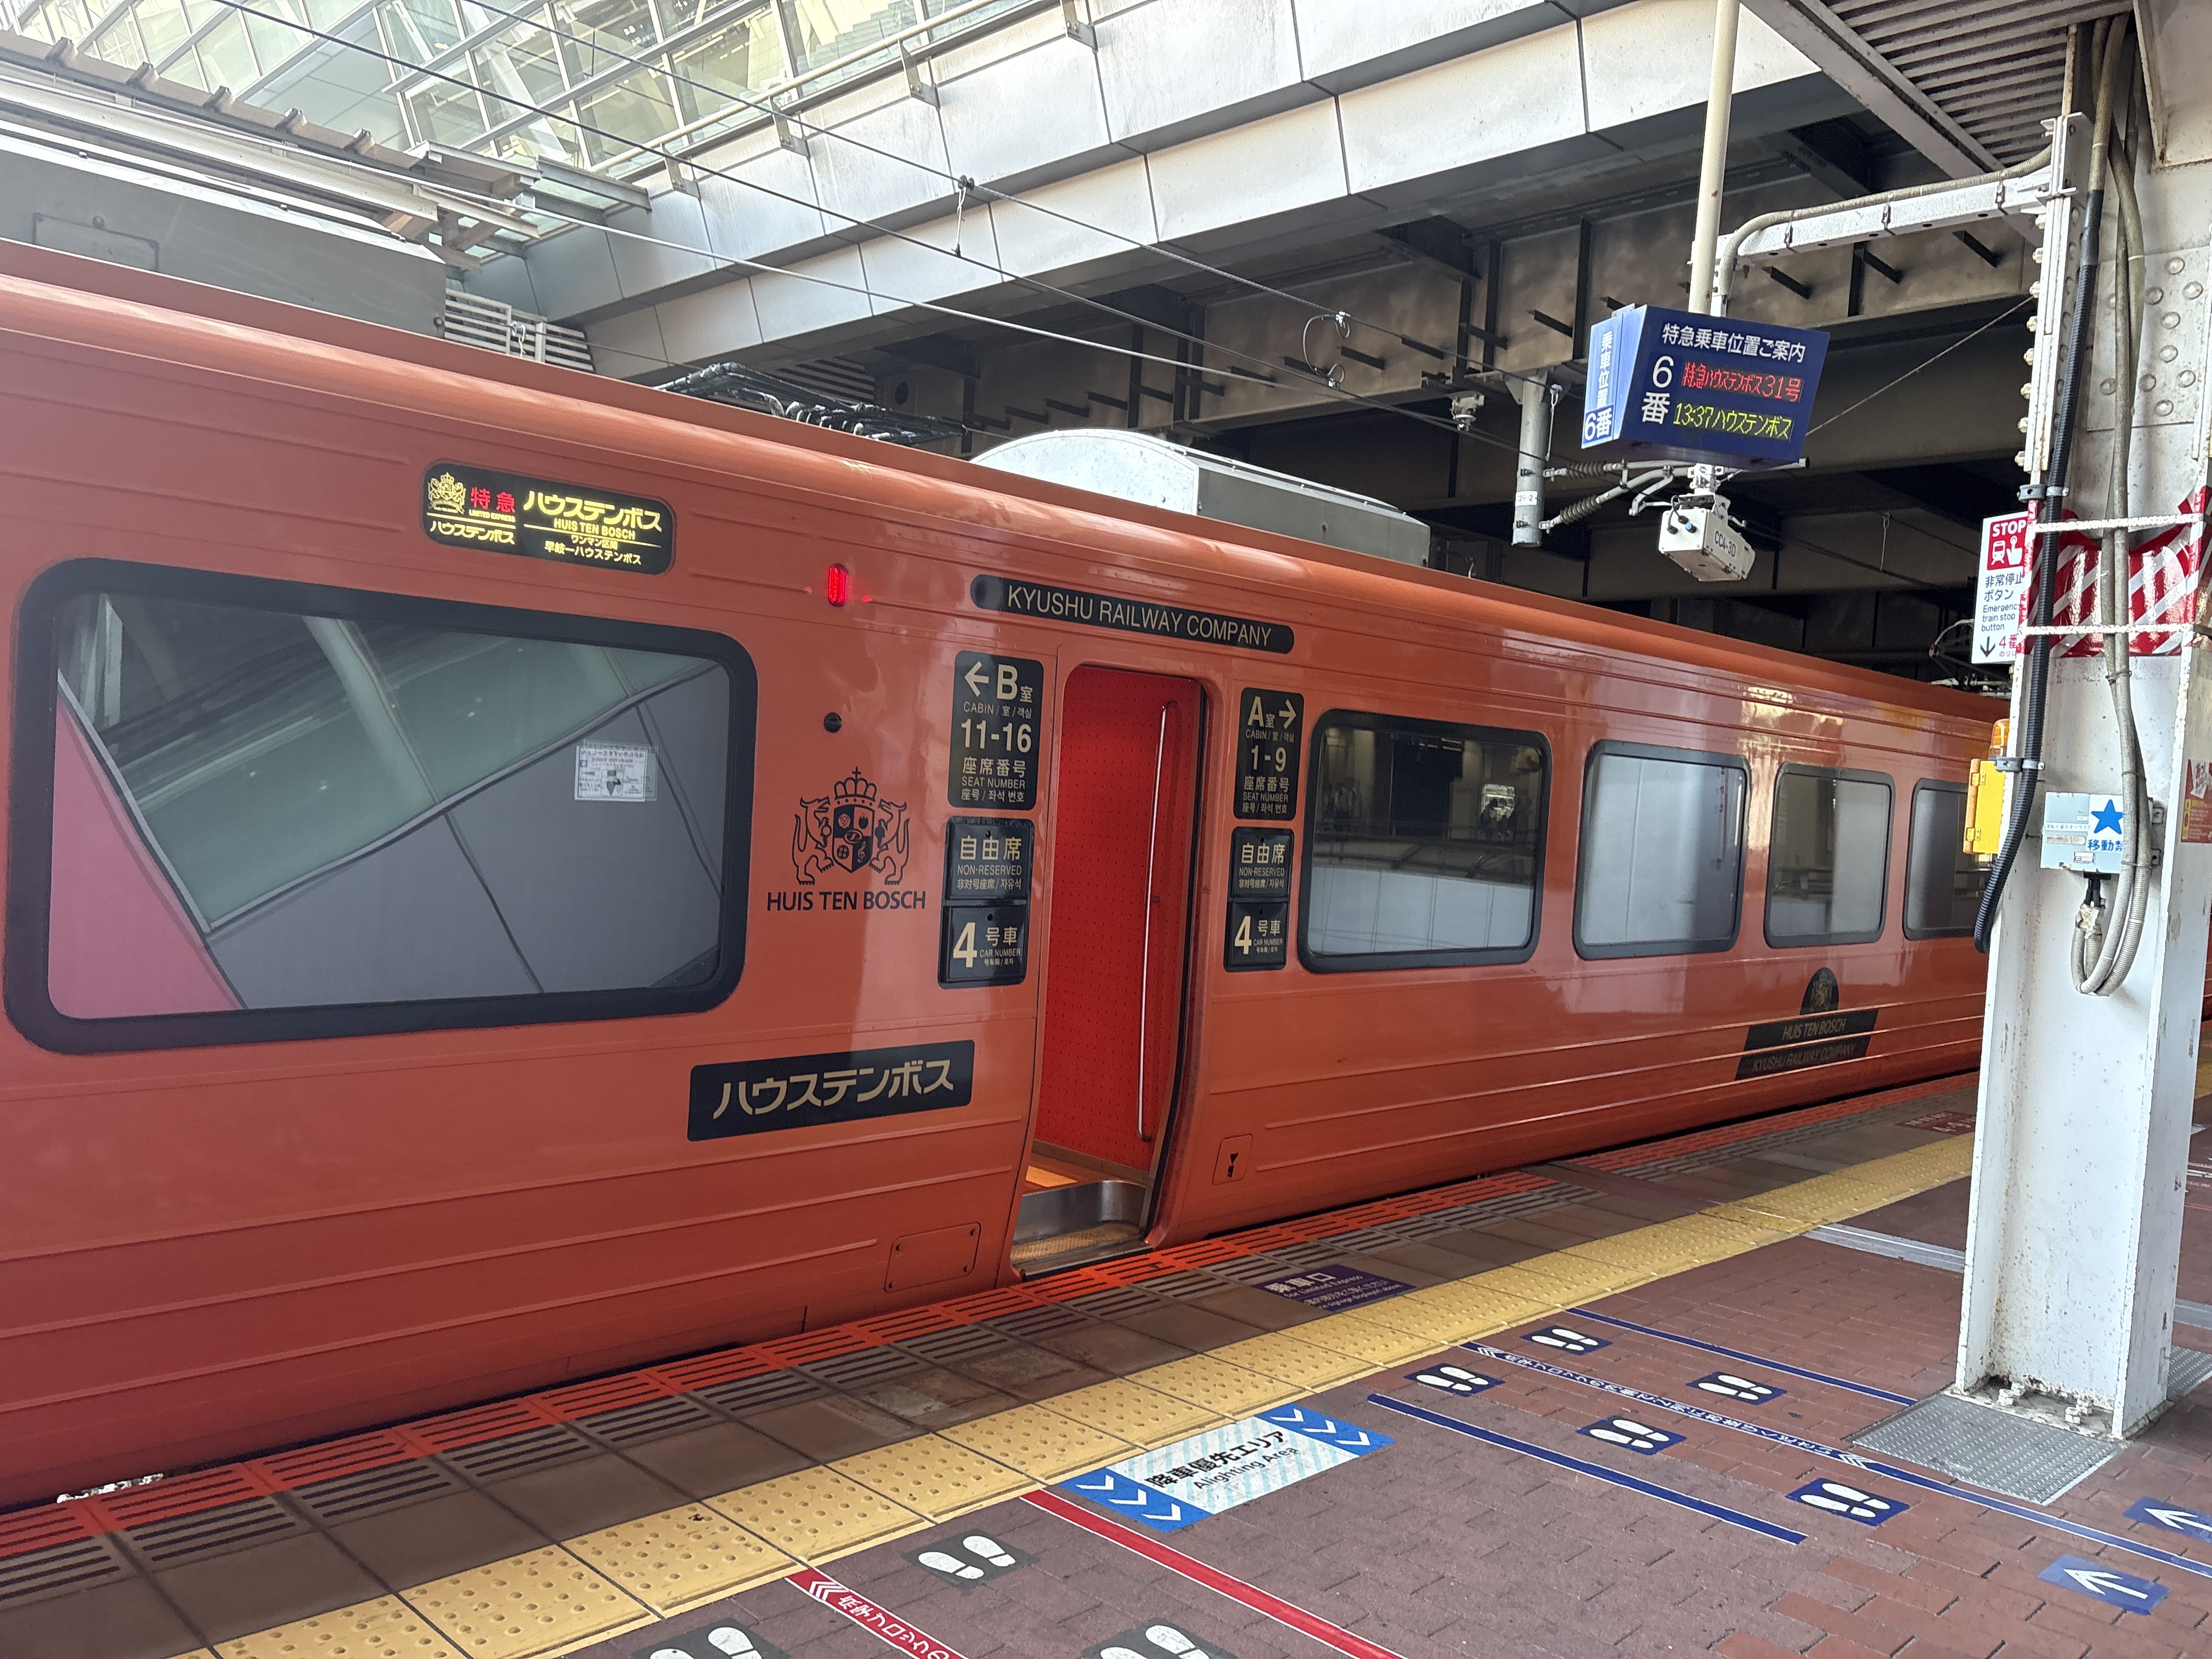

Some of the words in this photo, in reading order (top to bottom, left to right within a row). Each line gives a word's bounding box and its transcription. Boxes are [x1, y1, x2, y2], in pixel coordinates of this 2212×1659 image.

[1662, 323, 1806, 364] 特急乗車位置ご案内
[1597, 330, 1613, 409] 乗車位置
[1682, 361, 1801, 403] 特急ハウステンボス31号
[1584, 408, 1612, 441] 6番
[470, 487, 516, 514] 特急
[523, 490, 662, 533] ハウステンボス
[469, 509, 490, 518] LIMITED
[490, 512, 516, 522] EXPRESS
[430, 520, 515, 545] ハウステンボス
[554, 518, 578, 531] HUIS
[580, 522, 599, 535] TEN
[601, 525, 635, 540] BOSCH
[1992, 520, 2027, 538] STOP
[571, 534, 618, 550] ワンマン区間
[1985, 572, 2022, 588] 非常停止
[1984, 589, 2013, 602] ボタン
[1008, 584, 1093, 620] KYUSHU
[1099, 600, 1183, 634] RAILWAY
[1186, 615, 1272, 647] COMPANY
[1982, 614, 1999, 623] train
[2000, 612, 2016, 621] stop
[1983, 603, 2019, 613] Emergenc
[1982, 623, 2005, 632] button
[963, 701, 994, 715] CABIN
[961, 718, 1032, 753] 11-16
[1245, 729, 1267, 740] CABIN
[962, 756, 1026, 778] 座席番号
[1251, 744, 1286, 773] 1-9
[961, 776, 984, 787] SEAT
[988, 778, 1025, 789] NUMBER
[1244, 775, 1290, 793] 座席番号
[1243, 792, 1259, 802] SEAT
[1260, 793, 1289, 803] NUMBER
[960, 834, 1022, 861] 自由席
[1241, 842, 1285, 865] 自由席
[957, 864, 1023, 876] NON-RESERVED
[1239, 867, 1285, 877] NON-RESERVED
[767, 891, 814, 911] HUIS
[819, 891, 857, 910] TEN
[863, 890, 926, 910] BOSCH
[980, 949, 993, 958] CAR
[995, 948, 1021, 957] NUMBER
[1782, 1026, 1802, 1041] HUIS
[1804, 1022, 1819, 1037] TEN
[1820, 1018, 1847, 1034] BOSCH
[713, 1059, 954, 1120] ハウステンボス
[1144, 1431, 1284, 1488] 降車優先エリア
[1193, 1460, 1266, 1489] Alighting
[1261, 1447, 1299, 1463] Area
